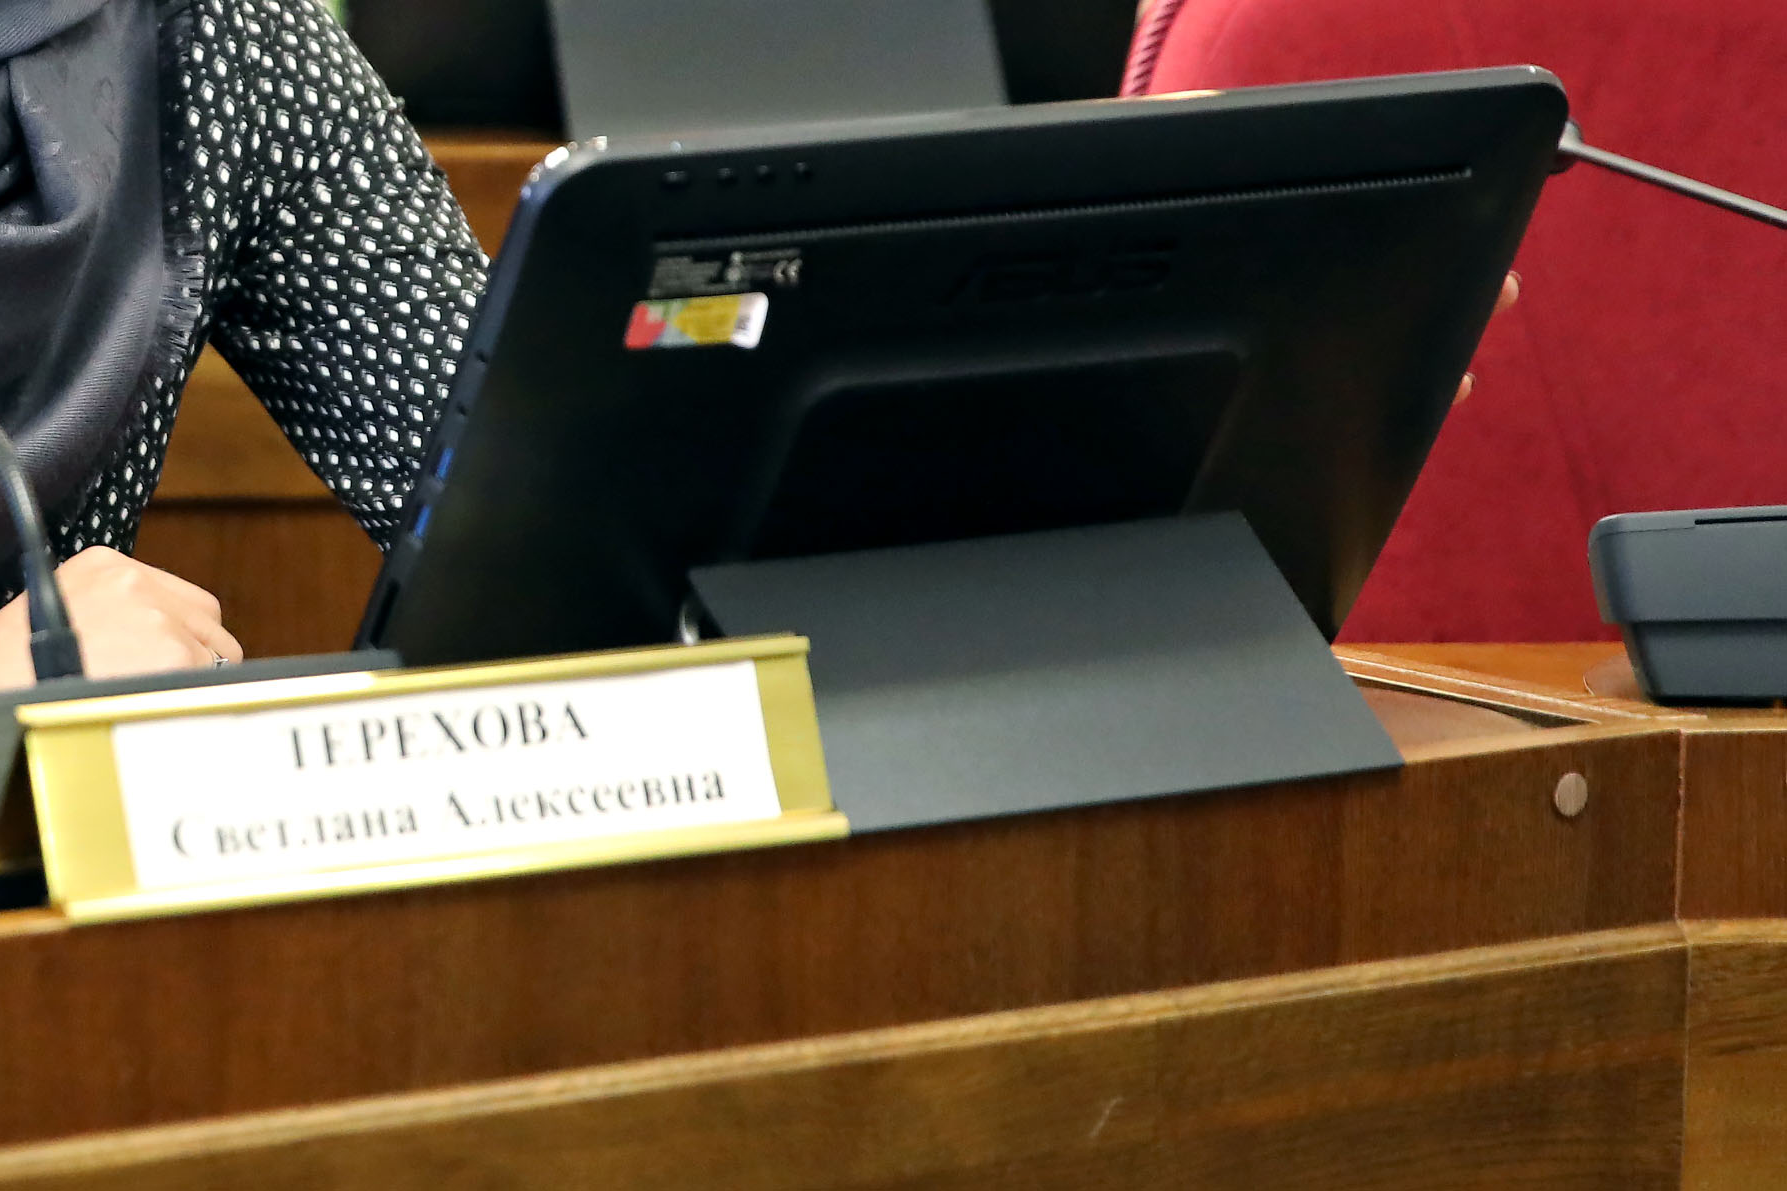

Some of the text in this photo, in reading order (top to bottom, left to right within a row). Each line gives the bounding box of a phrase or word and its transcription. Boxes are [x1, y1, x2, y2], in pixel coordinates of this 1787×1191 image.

[284, 701, 589, 769] ТЕРЕХОВА
[170, 770, 726, 857] Светлана Алексеевна
